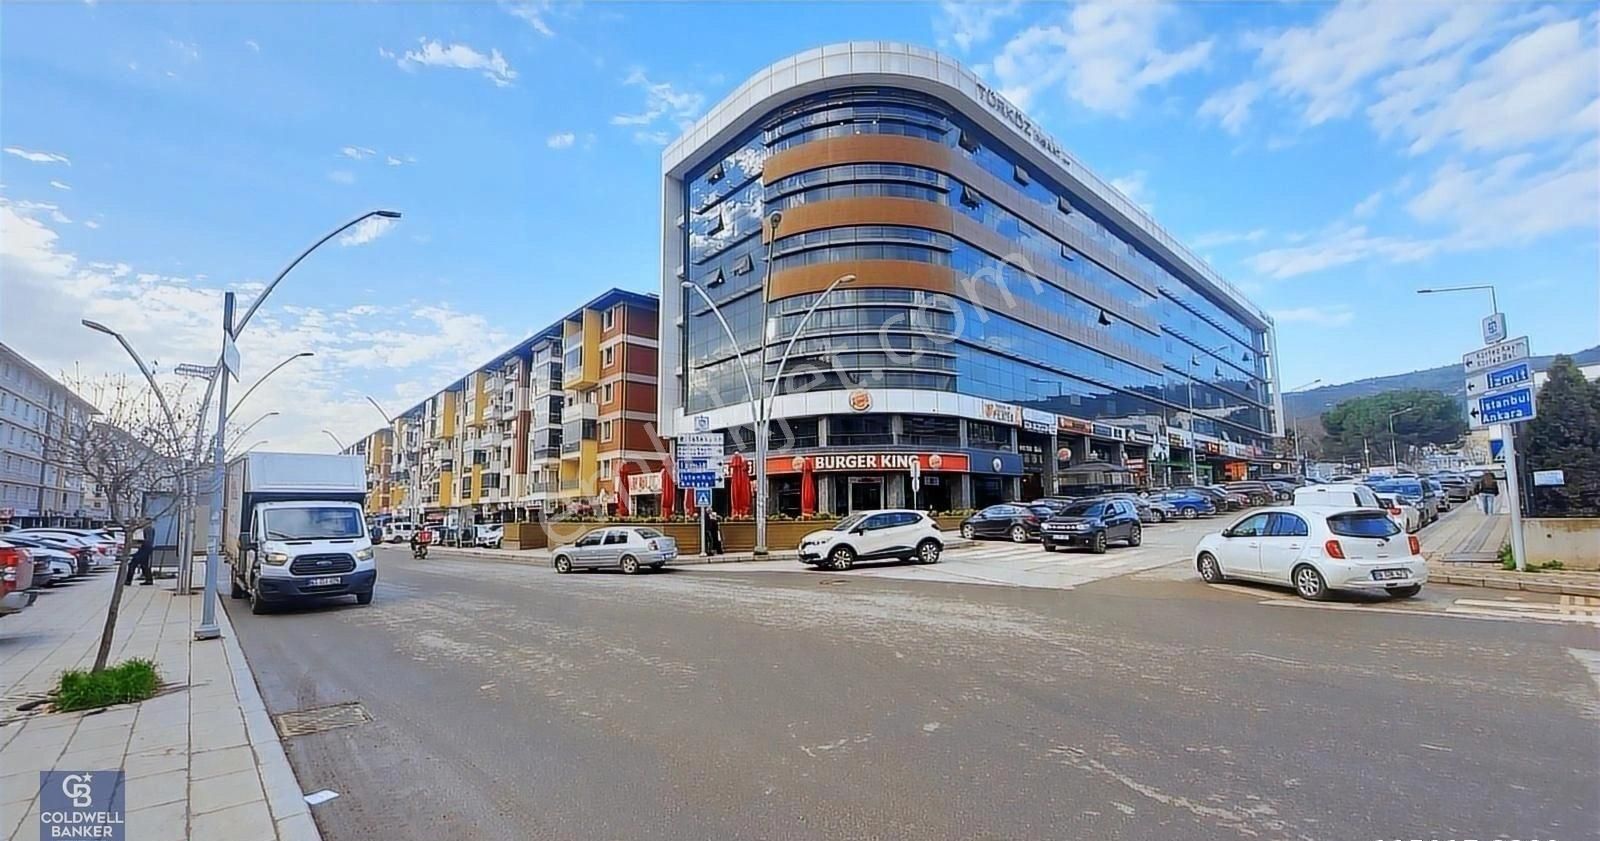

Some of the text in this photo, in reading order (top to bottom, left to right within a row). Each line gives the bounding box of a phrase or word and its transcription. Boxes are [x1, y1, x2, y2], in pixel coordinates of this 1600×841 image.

[976, 83, 1032, 137] TÜRKÖZ
[1482, 408, 1523, 423] Ankara
[815, 455, 920, 469] BURGER KING
